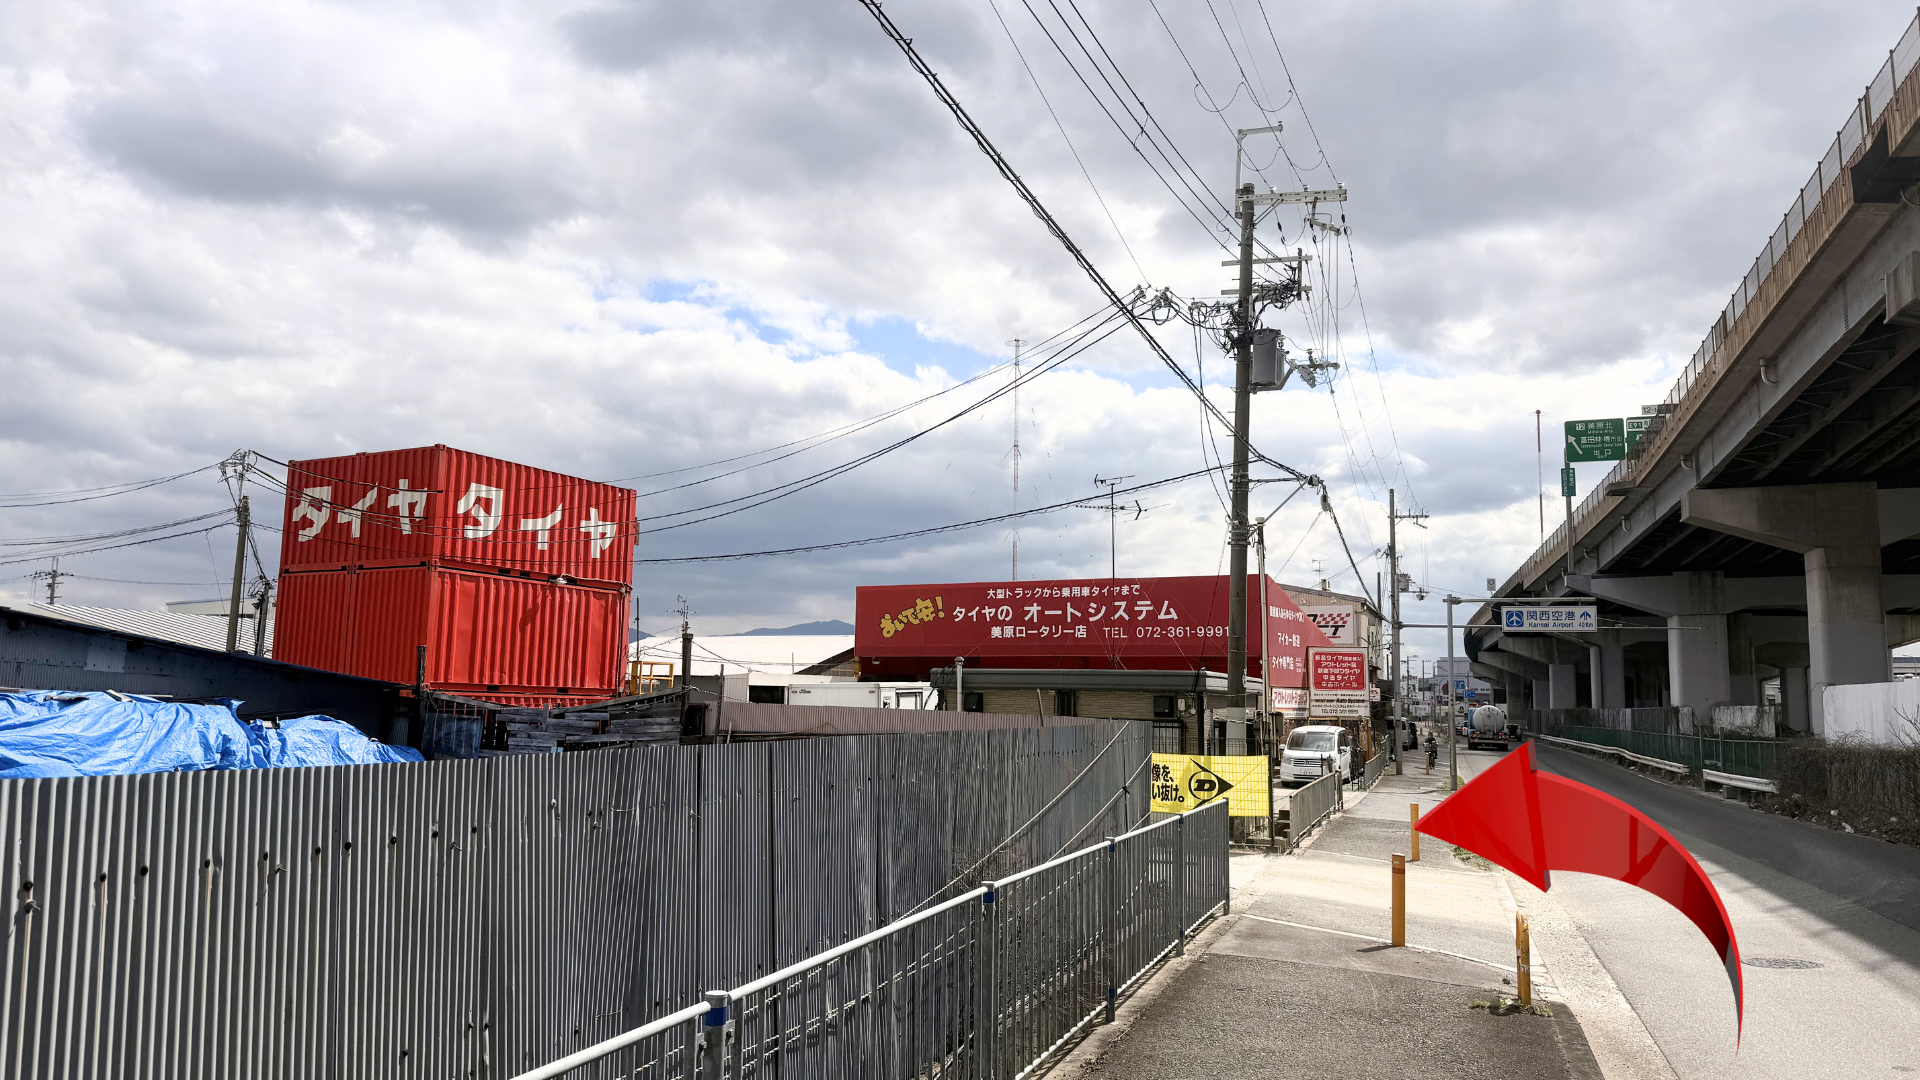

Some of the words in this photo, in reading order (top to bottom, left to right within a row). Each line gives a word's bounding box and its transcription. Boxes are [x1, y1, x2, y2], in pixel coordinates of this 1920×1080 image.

[292, 478, 428, 542] タイヤ
[457, 482, 617, 559] タイヤ
[986, 584, 1141, 600] 大型トラックから乗用車タイヤまで
[952, 605, 1013, 622] タイヤの
[1023, 600, 1179, 623] オートシステム
[1526, 610, 1576, 621] 関西空港
[990, 625, 1087, 639] 美原ロータリー店
[1102, 627, 1128, 639] TEL
[1136, 625, 1230, 638] 072-361-9991
[1552, 621, 1574, 629] Airport
[1272, 655, 1294, 670] タイヤ専門店
[1152, 763, 1174, 783] 像を、
[1152, 783, 1185, 803] い抜け。
